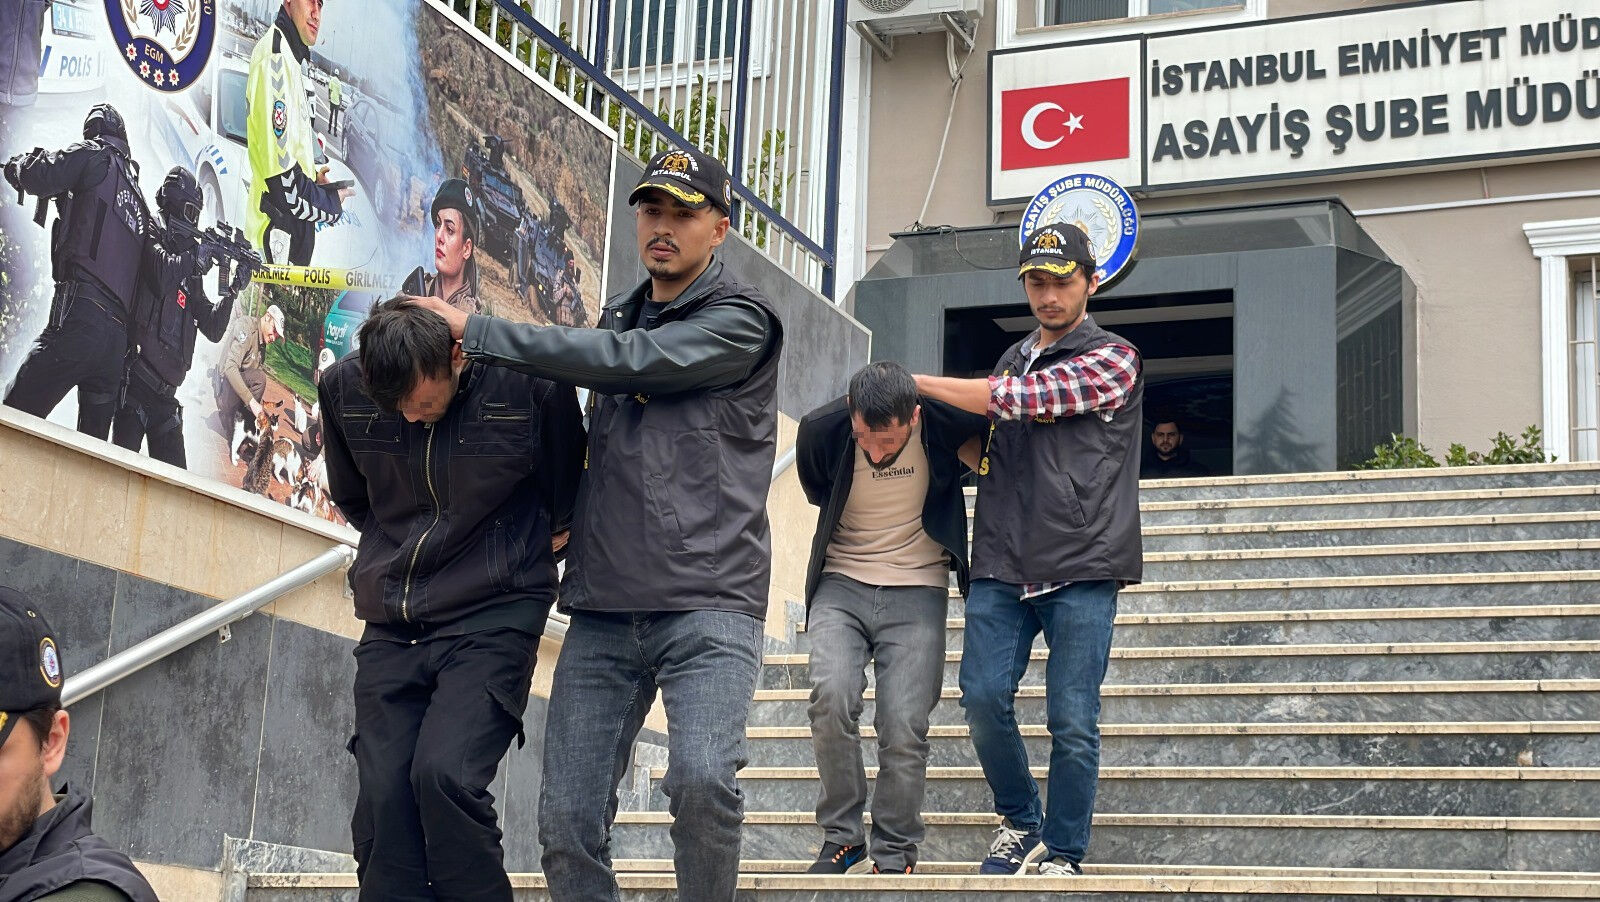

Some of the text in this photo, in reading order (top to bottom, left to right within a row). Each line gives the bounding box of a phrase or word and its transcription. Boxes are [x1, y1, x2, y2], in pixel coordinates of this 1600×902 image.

[59, 54, 92, 78] POLİS
[144, 43, 164, 65] EGM
[1151, 49, 1327, 97] İSTANBUL
[1338, 27, 1507, 77] EMNİYET
[1152, 69, 1600, 162] ASAYİŞ ŞUBE MÜDÜ
[1024, 177, 1135, 237] ASAYİŞ ŞUBE MÜDÜRLÜĞÜ
[303, 268, 331, 285] POLİS
[345, 270, 397, 289] GİRİLMEZ
[872, 466, 915, 479] Essential
